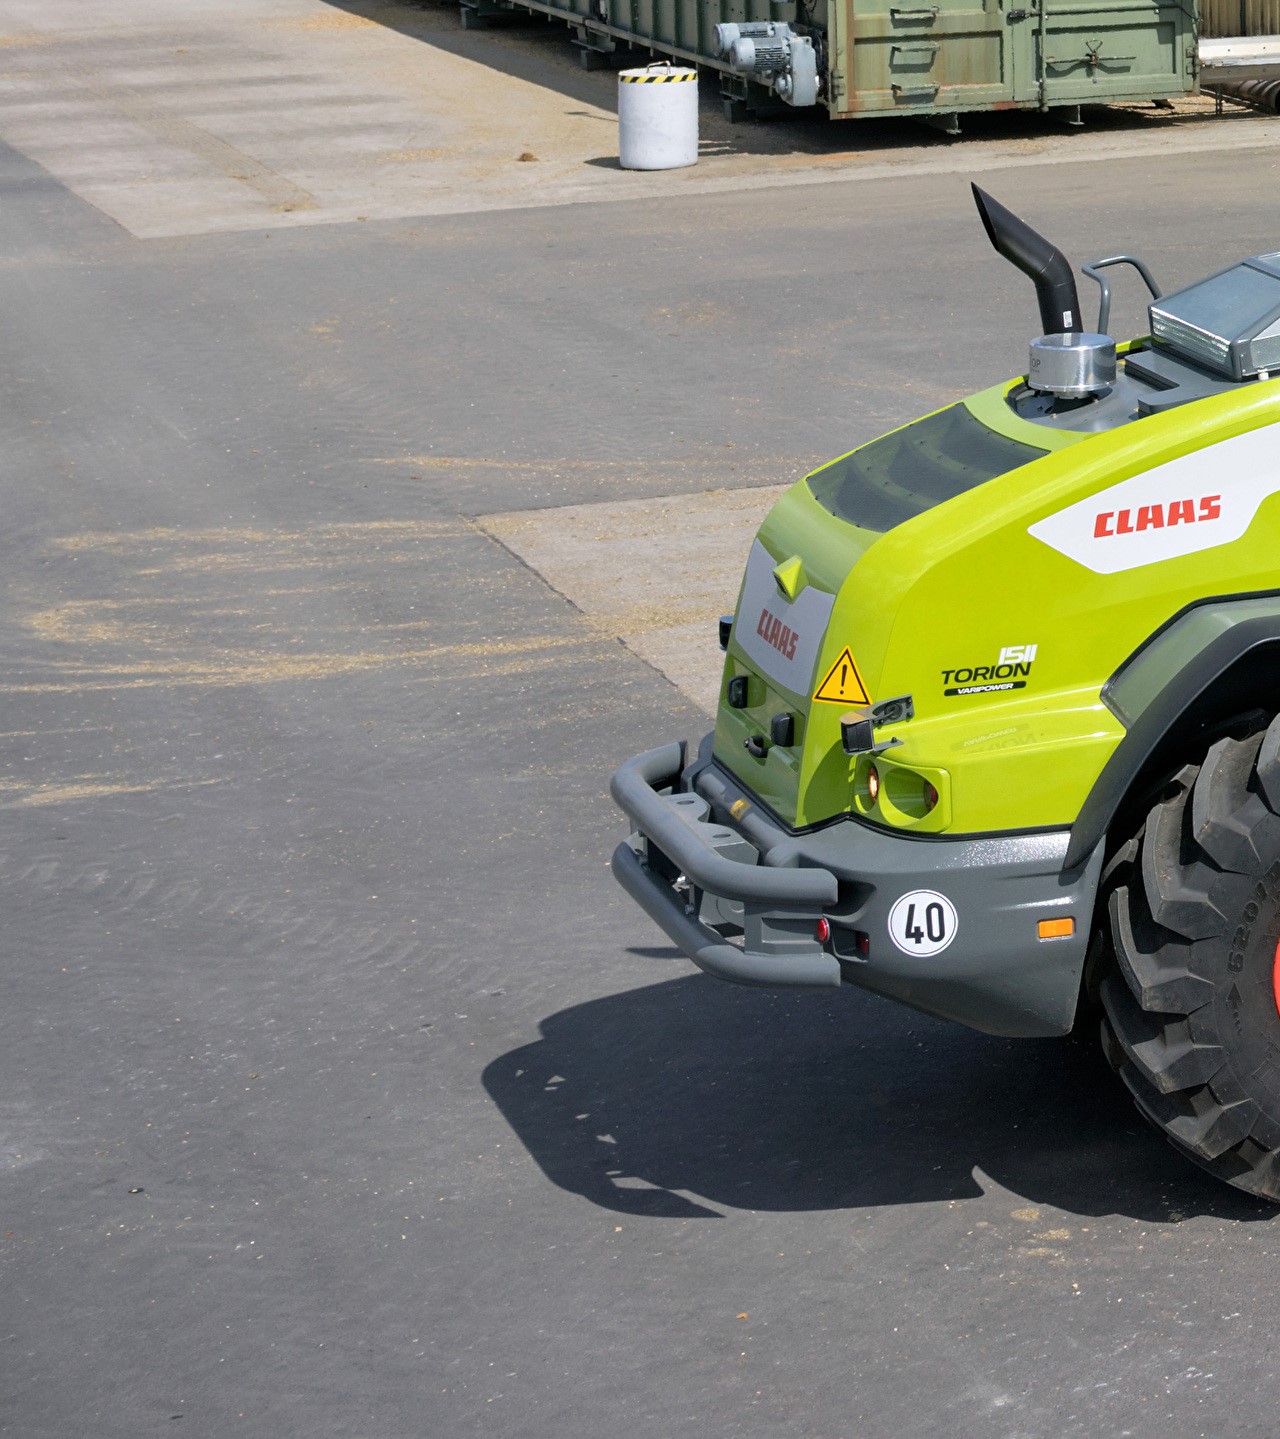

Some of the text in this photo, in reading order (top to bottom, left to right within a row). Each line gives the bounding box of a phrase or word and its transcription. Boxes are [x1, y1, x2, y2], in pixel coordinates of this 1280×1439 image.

[1093, 495, 1221, 538] CLAAS
[757, 608, 799, 661] CLAAS
[998, 644, 1038, 665] 1511
[942, 661, 1032, 685] TORION
[957, 683, 1014, 695] VARIPOWER
[905, 902, 945, 944] 40
